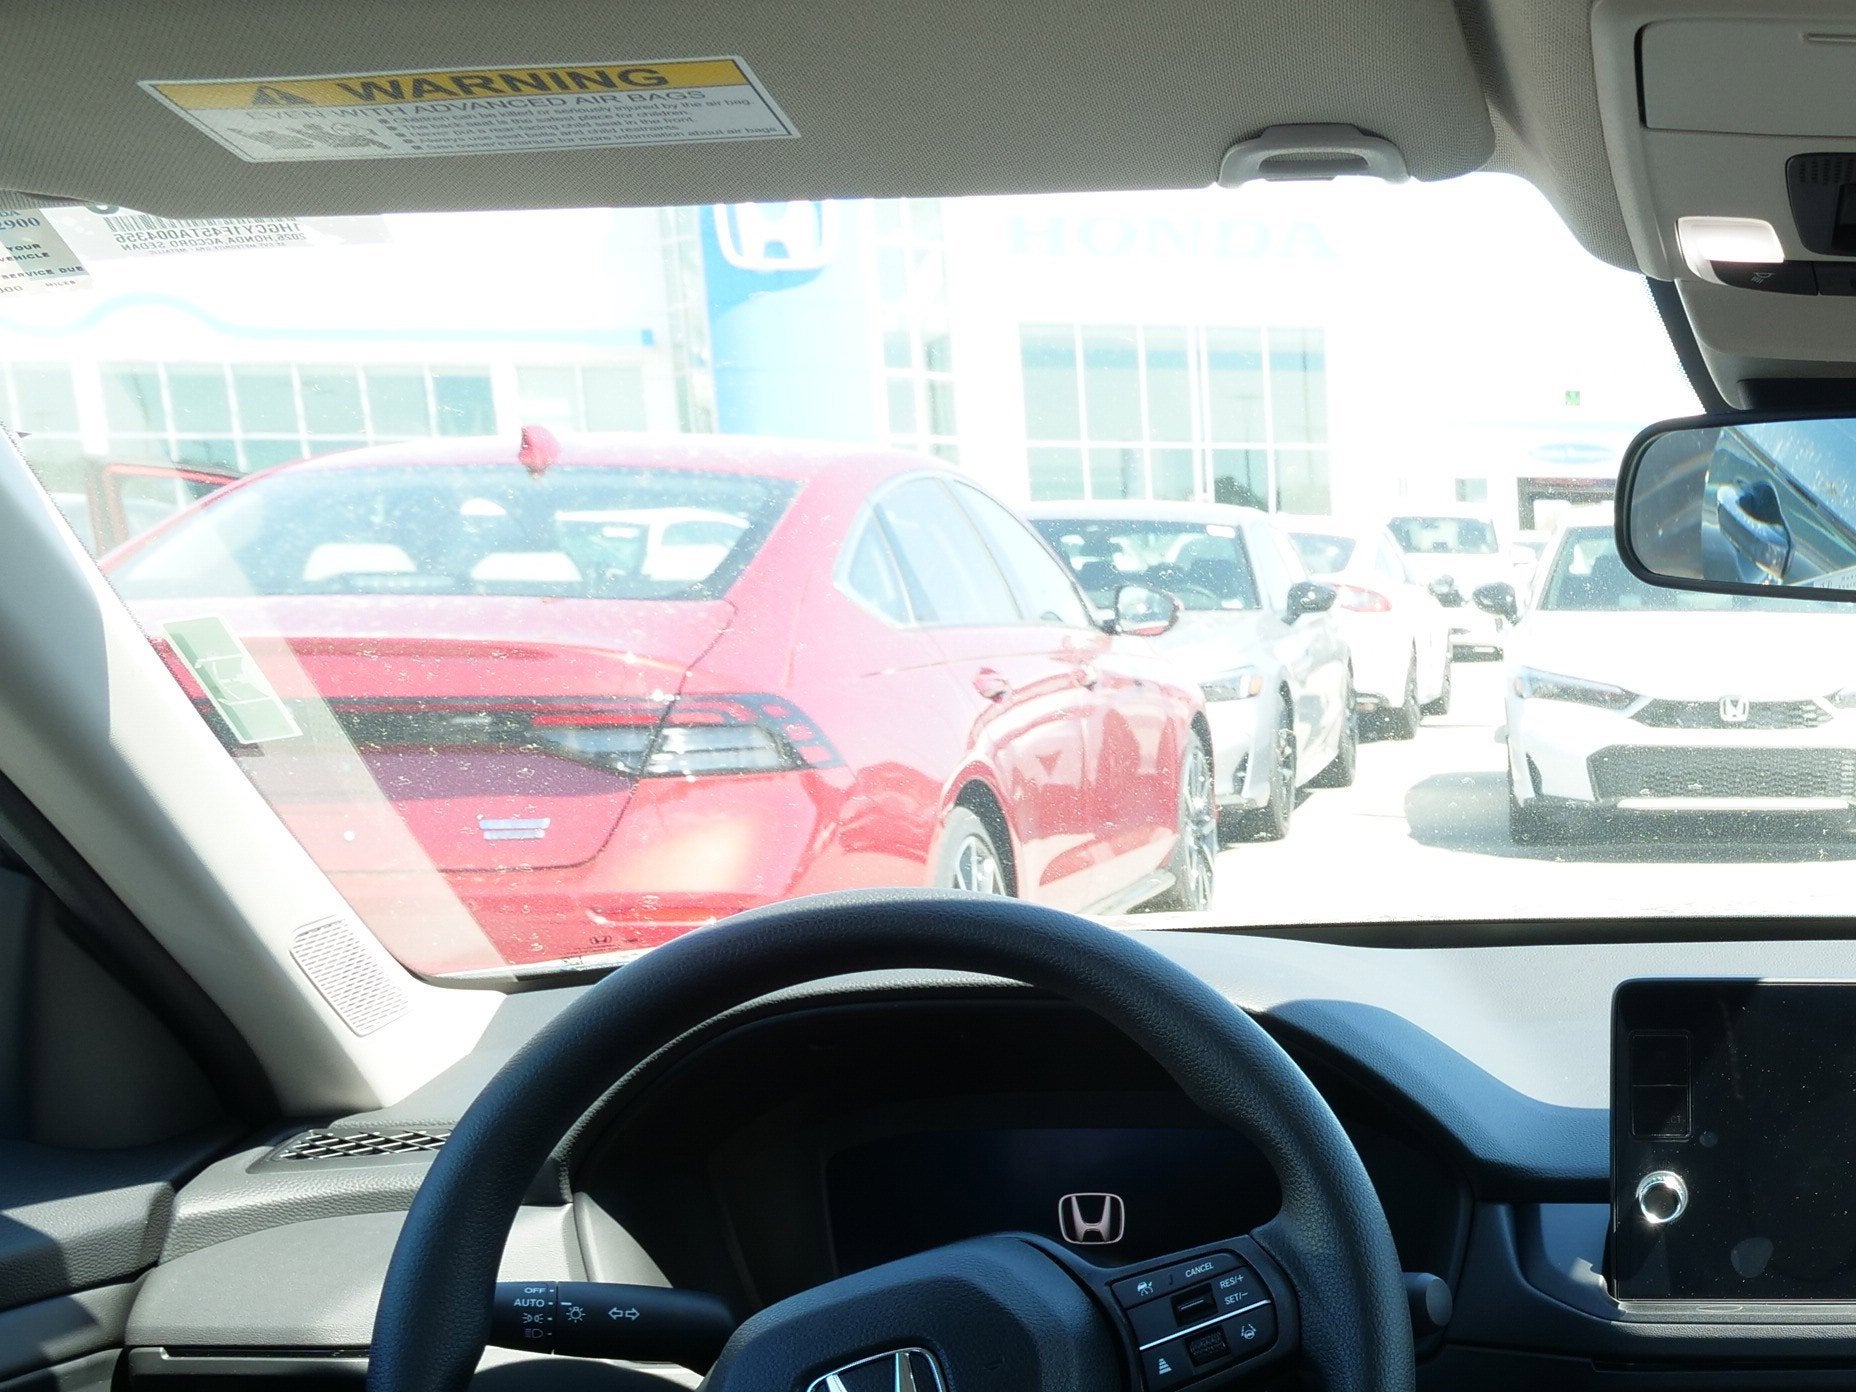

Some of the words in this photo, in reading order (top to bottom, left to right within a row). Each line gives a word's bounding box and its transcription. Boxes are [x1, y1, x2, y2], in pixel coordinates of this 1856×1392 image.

[335, 68, 669, 101] WARNING
[331, 105, 409, 119] WITH
[413, 97, 568, 114] ADVANCED
[576, 95, 621, 106] AIR
[627, 90, 706, 102] BAGS
[1007, 214, 1338, 262] HONDA
[6, 243, 41, 252] YOUR
[0, 252, 50, 262] VEHICLE
[2, 269, 55, 279] SERVICE
[58, 266, 84, 274] DUE
[1185, 1261, 1214, 1278] CANCEL
[1219, 1274, 1245, 1290] RES/+
[514, 1299, 544, 1308] AUTO
